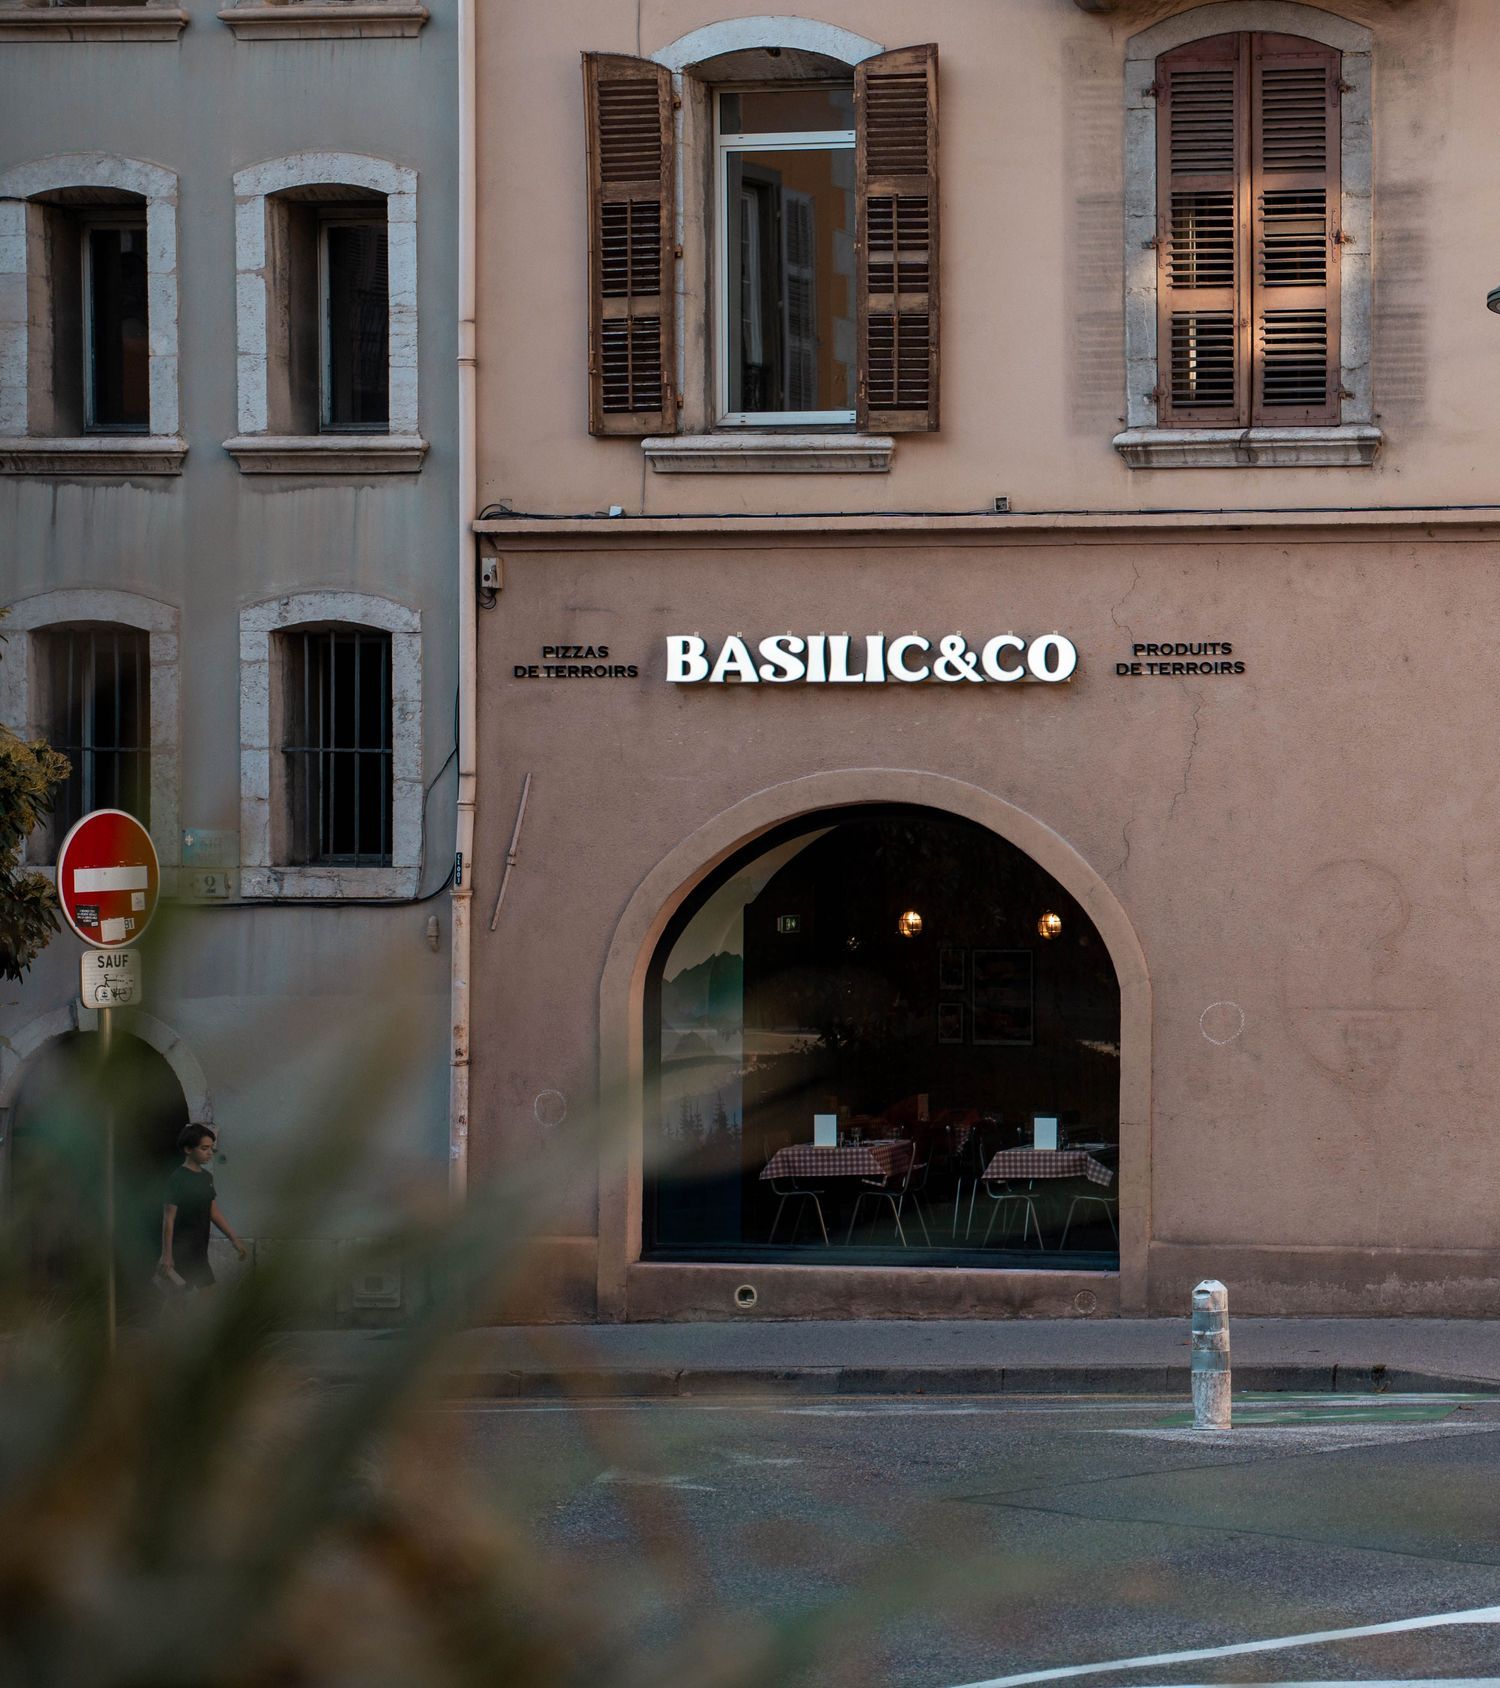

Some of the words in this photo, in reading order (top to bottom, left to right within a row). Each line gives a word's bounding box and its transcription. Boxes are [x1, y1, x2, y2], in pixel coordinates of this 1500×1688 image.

[542, 645, 609, 659] PIZZAS
[1132, 642, 1233, 656] PRODUITS
[666, 634, 1077, 683] BASILIC&CO
[513, 664, 539, 678] DE
[543, 664, 639, 678] TERROIRS
[1115, 662, 1142, 676] DE
[1146, 661, 1246, 675] TERROIRS
[97, 954, 129, 969] SAUF
